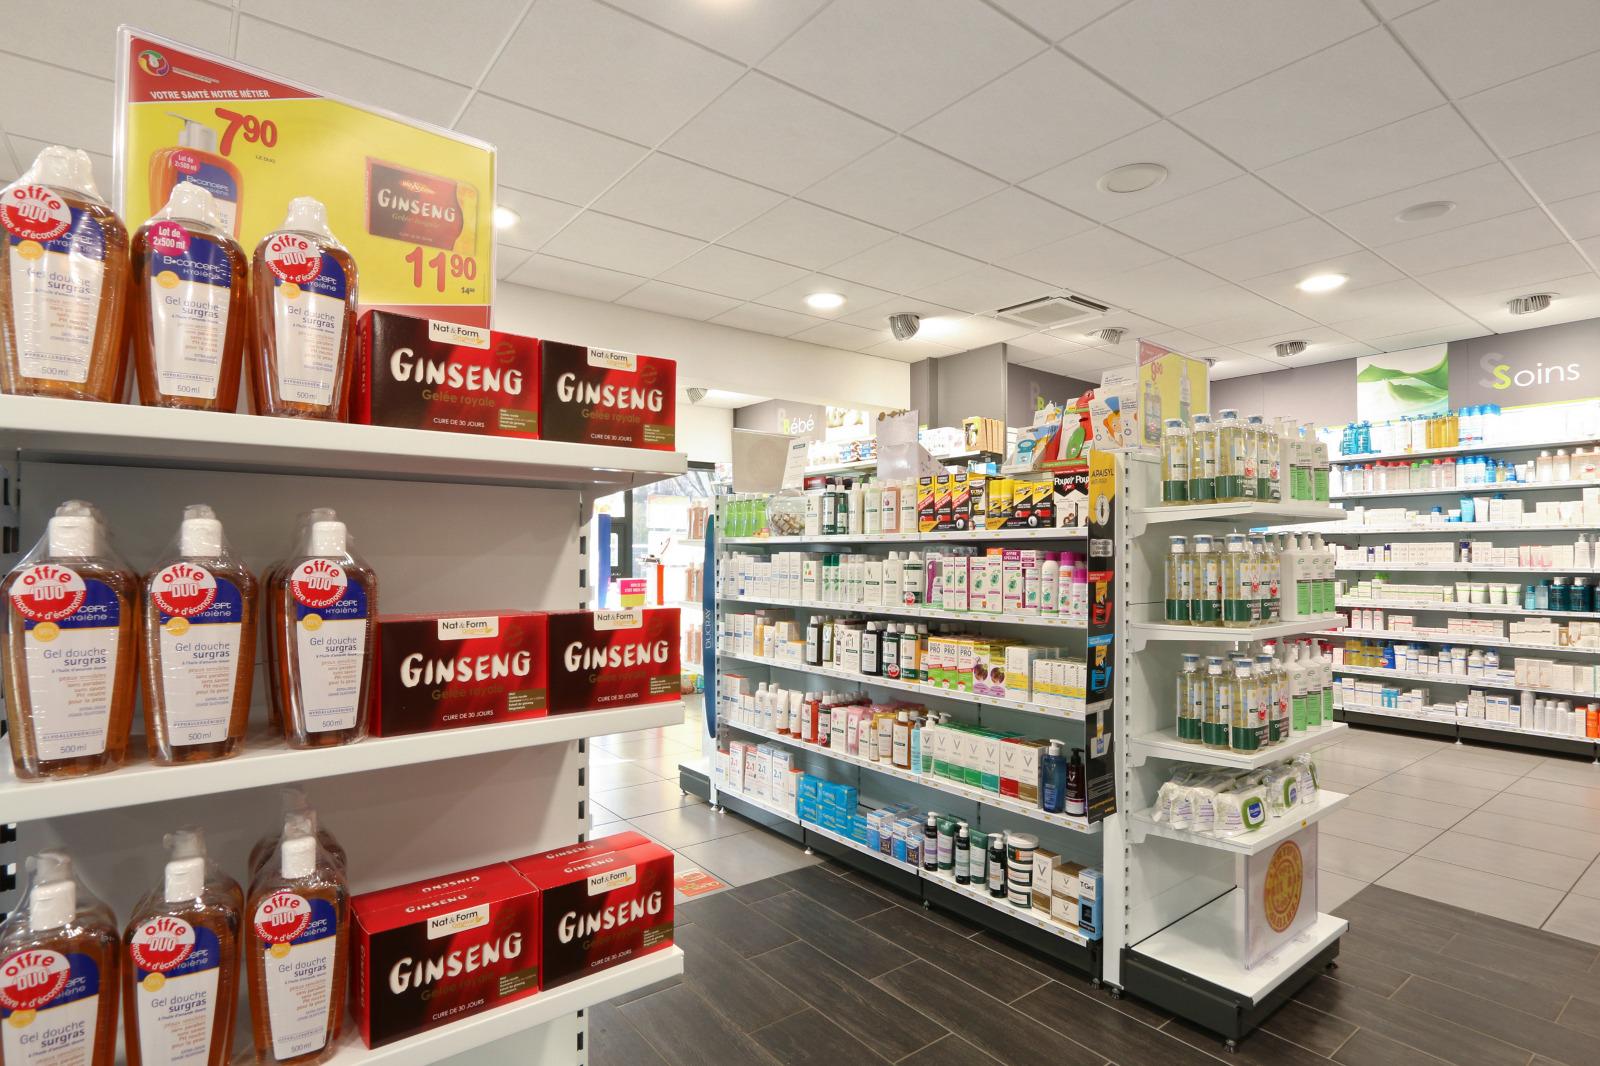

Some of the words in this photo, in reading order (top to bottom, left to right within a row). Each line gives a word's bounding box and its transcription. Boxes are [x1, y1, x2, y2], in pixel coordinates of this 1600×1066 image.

[150, 91, 180, 100] VOTRE
[181, 89, 210, 99] SANTÉ
[211, 90, 238, 98] NOTRE
[239, 88, 270, 98] MÉTIER
[14, 186, 61, 210] offre
[378, 188, 456, 223] GINSENG
[18, 203, 49, 223] DUO
[159, 226, 170, 236] Lot
[172, 228, 181, 238] de
[153, 236, 175, 247] 2x500
[176, 241, 186, 249] ml
[272, 235, 308, 252] offre
[283, 252, 307, 266] DUO
[166, 296, 181, 305] Gel
[184, 300, 219, 311] douche
[183, 307, 219, 318] surgras
[303, 316, 335, 329] surgras
[433, 323, 450, 334] Nat
[457, 327, 479, 338] Form
[590, 350, 603, 358] Nat
[610, 354, 628, 362] Form
[390, 348, 523, 395] GINSENG
[1491, 362, 1581, 390] Soins
[557, 372, 664, 412] GINSENG
[433, 417, 449, 425] CURE
[783, 414, 815, 435] Bébé
[23, 566, 72, 585] offre
[162, 565, 205, 583] offre
[304, 561, 339, 577] offre
[172, 583, 199, 598] DUO
[308, 577, 332, 591] DUO
[34, 585, 65, 601] DUO
[616, 612, 634, 620] Form
[442, 621, 459, 630] Nat
[466, 620, 488, 629] Form
[706, 608, 714, 649] DUCRAY
[176, 643, 192, 652] Gel
[195, 642, 230, 651] douche
[310, 637, 324, 645] Gel
[327, 637, 357, 645] douche
[326, 644, 357, 653] surgras
[44, 649, 62, 659] Gel
[66, 648, 107, 658] douche
[64, 656, 107, 667] surgras
[193, 650, 230, 660] surgras
[564, 640, 669, 672] GINSENG
[400, 651, 531, 688] GINSENG
[443, 714, 459, 722] CURE
[476, 710, 494, 718] JOURS
[546, 844, 595, 859] GINSENG
[563, 857, 614, 874] GINSENG
[421, 876, 480, 893] GINSENG
[591, 877, 605, 886] Nat
[610, 871, 627, 882] Form
[264, 896, 300, 914] offre
[405, 894, 468, 914] GINSENG
[272, 912, 295, 926] DUO
[431, 918, 449, 930] Nat
[456, 910, 478, 923] Form
[558, 891, 662, 945] GINSENG
[145, 919, 186, 936] offre
[149, 938, 176, 952] DUO
[5, 954, 54, 976] offre
[279, 963, 293, 973] Gel
[296, 957, 326, 969] douche
[294, 964, 326, 977] surgras
[389, 932, 522, 995] GINSENG
[17, 970, 49, 991] DUO
[152, 998, 167, 1008] Gel
[171, 991, 207, 1005] douche
[169, 999, 207, 1013] surgras
[432, 1010, 449, 1020] CURE
[450, 1008, 458, 1016] DE
[459, 1005, 467, 1013] 30
[467, 999, 484, 1011] JOURS
[20, 1032, 39, 1045] Gel
[43, 1021, 85, 1039] douche
[41, 1029, 85, 1048] surgras
